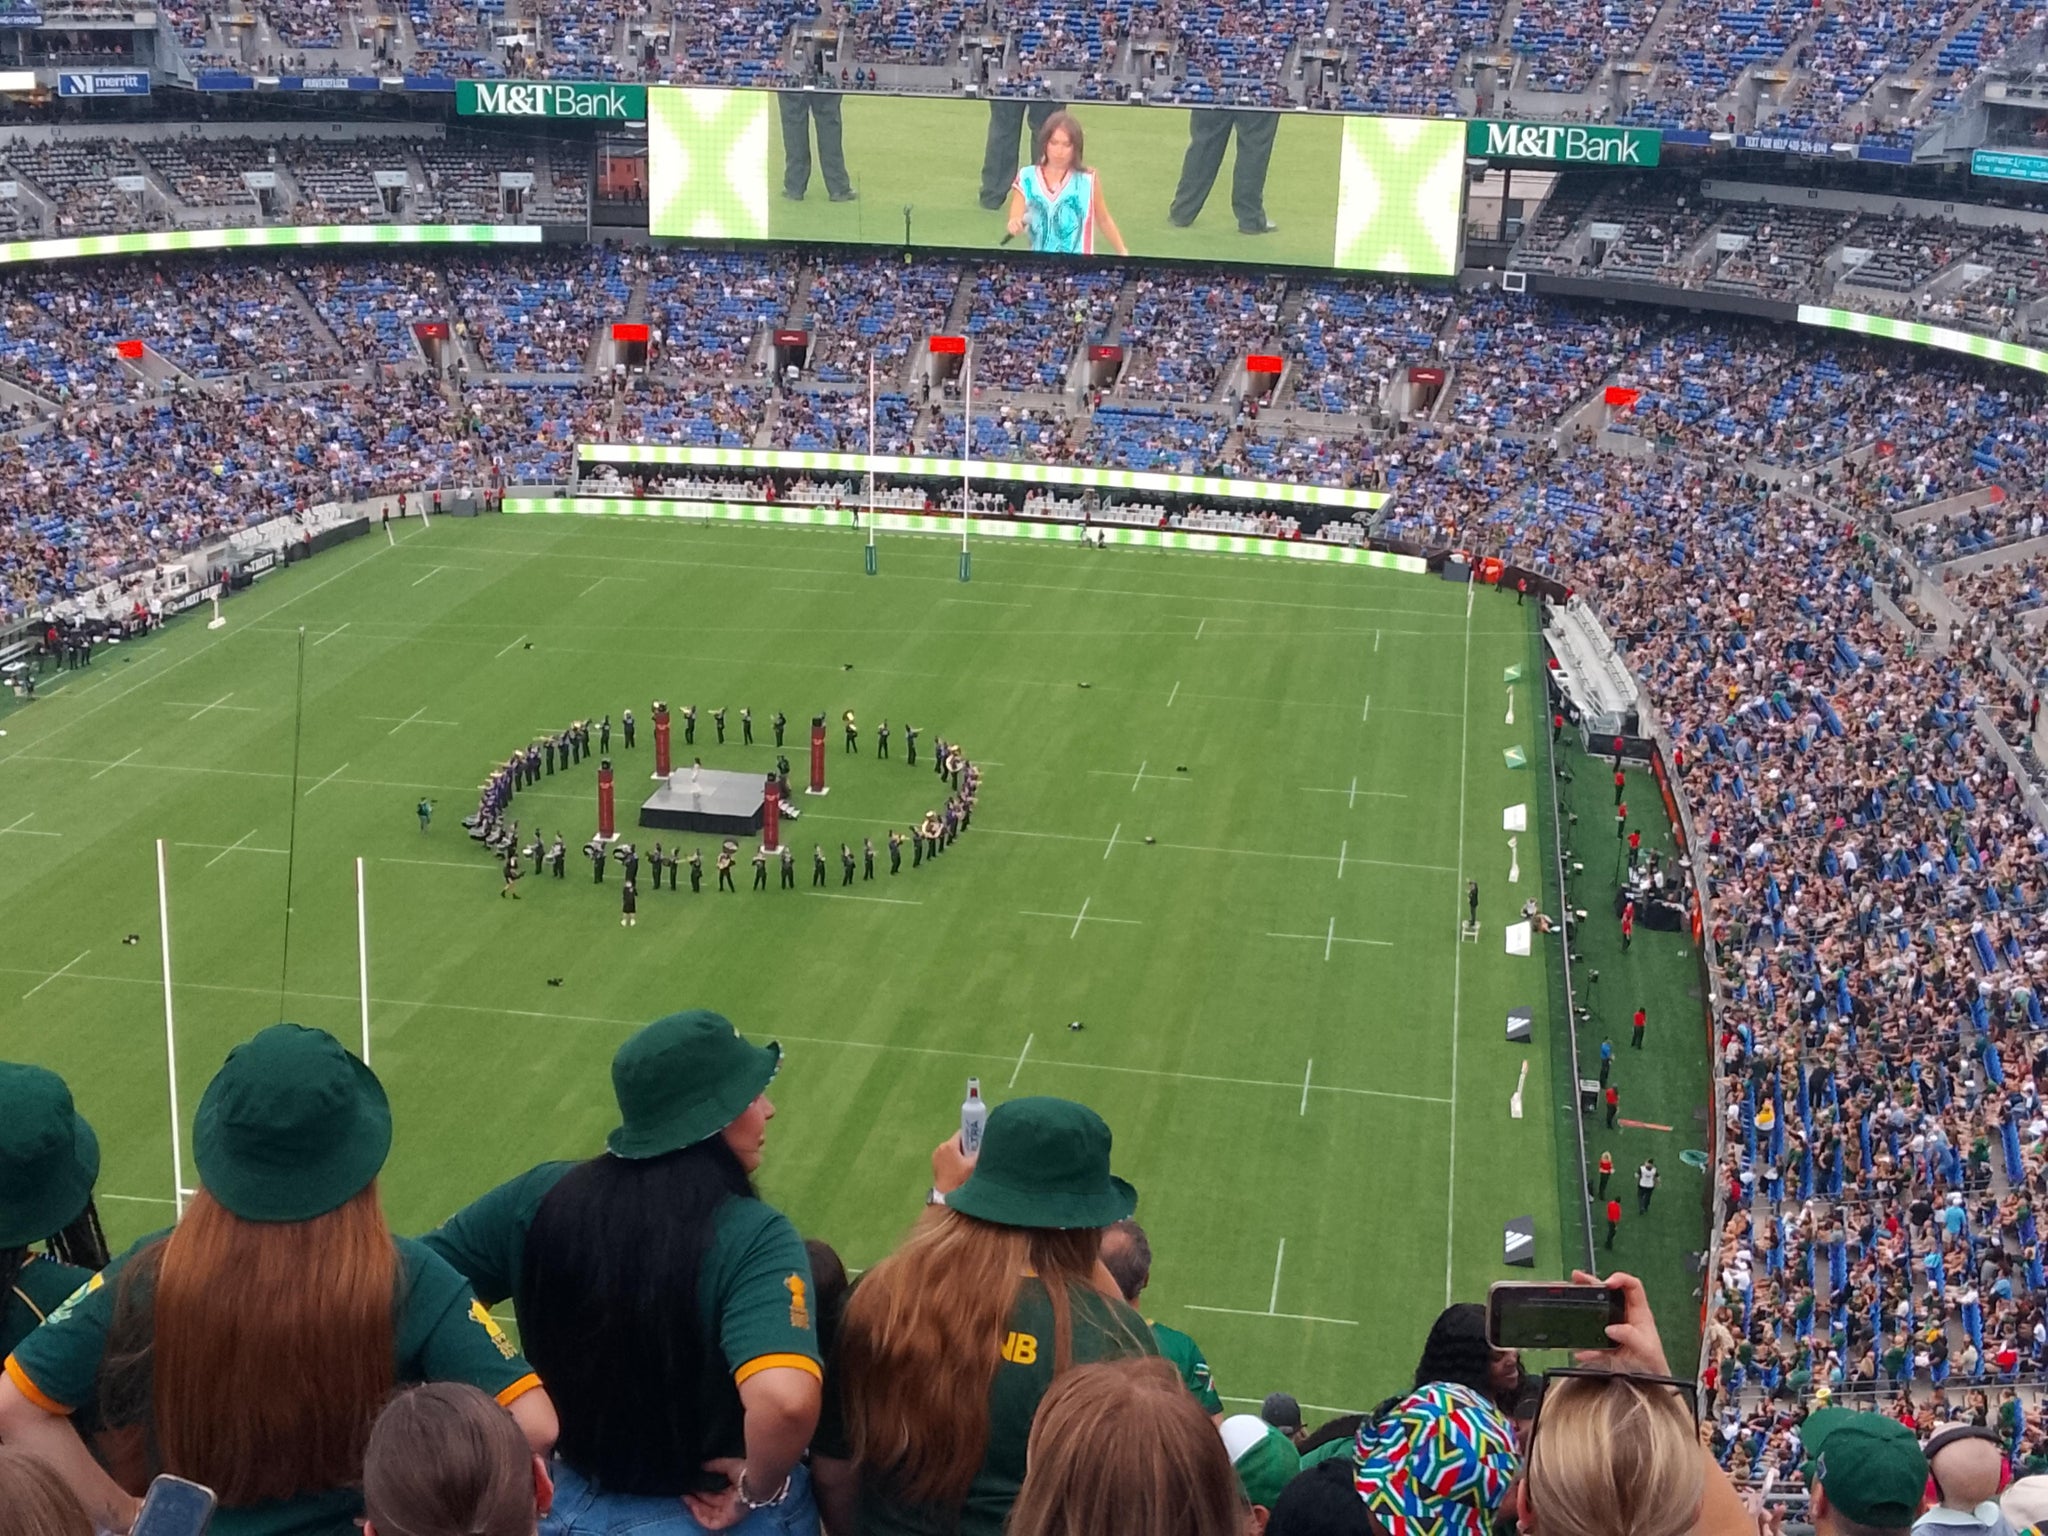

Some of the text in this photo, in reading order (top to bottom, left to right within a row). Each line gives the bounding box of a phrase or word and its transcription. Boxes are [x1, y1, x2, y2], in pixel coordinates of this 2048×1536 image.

[95, 75, 139, 87] merritt
[474, 84, 628, 117] M&T Bank
[1485, 123, 1640, 163] M&T Bank
